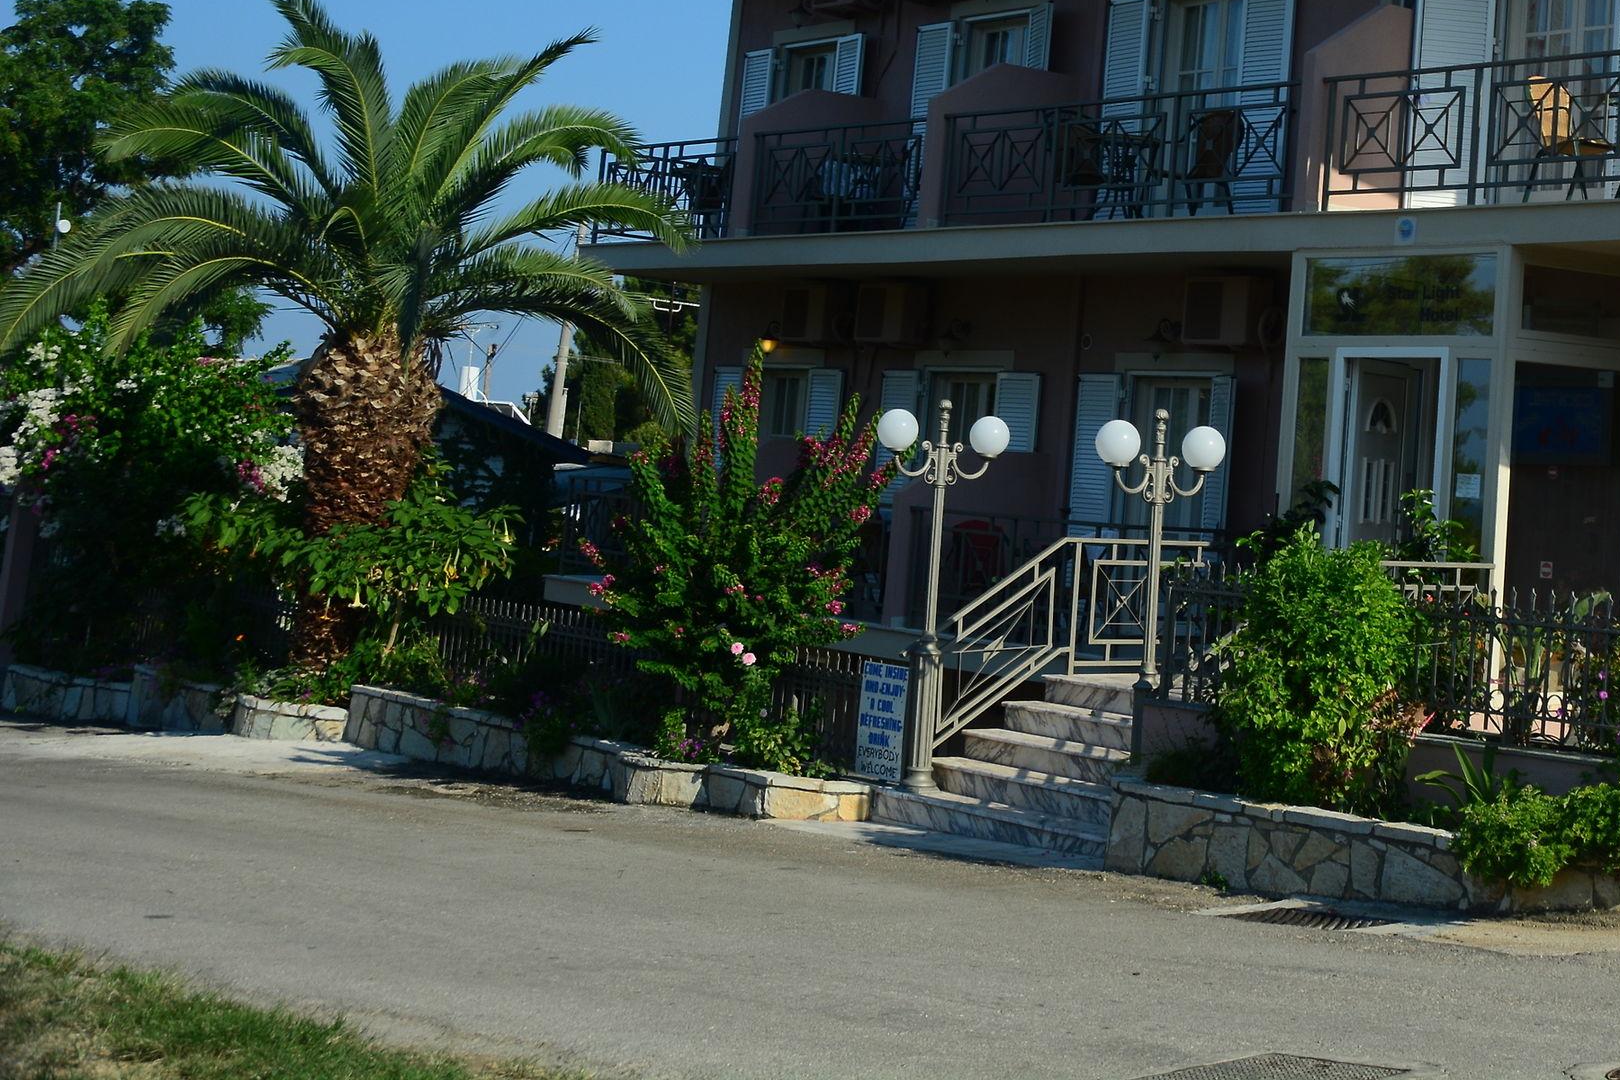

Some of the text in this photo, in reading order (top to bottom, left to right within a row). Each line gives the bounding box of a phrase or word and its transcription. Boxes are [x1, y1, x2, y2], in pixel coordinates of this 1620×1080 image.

[1420, 307, 1458, 321] Hotel
[864, 662, 908, 681] COME INSIDE
[865, 679, 879, 693] AND
[870, 698, 894, 713] A COOL
[860, 713, 902, 732] REFRESHING
[868, 732, 890, 747] DRINK
[858, 745, 899, 763] EVERYBODY
[861, 761, 897, 778] WELCOME
